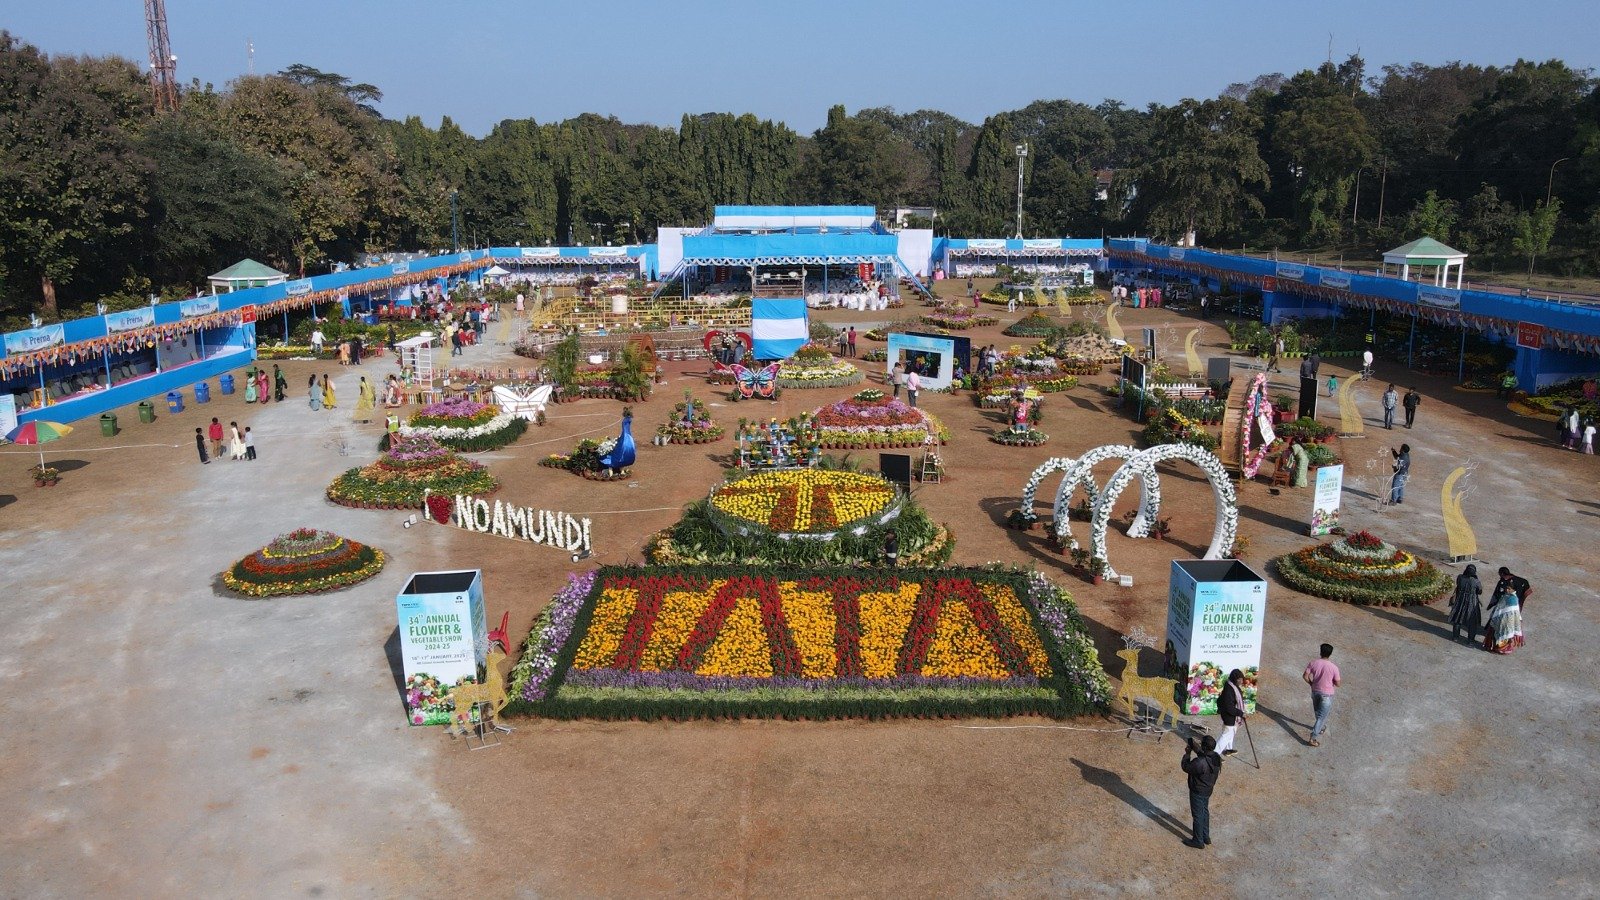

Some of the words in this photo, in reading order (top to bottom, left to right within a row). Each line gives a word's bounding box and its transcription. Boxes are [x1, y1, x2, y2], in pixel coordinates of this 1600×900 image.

[126, 315, 143, 325] Prerna
[29, 335, 51, 346] Prerna
[456, 494, 592, 551] NOAMUNDI
[1220, 603, 1254, 612] ANNUAL
[426, 614, 461, 624] ANNUAL
[1202, 613, 1243, 625] FLOWER
[1246, 613, 1253, 624] &
[410, 624, 451, 636] FLOWER
[453, 624, 461, 634] &
[604, 576, 1029, 678] TATA
[411, 636, 444, 644] VEGETABLE
